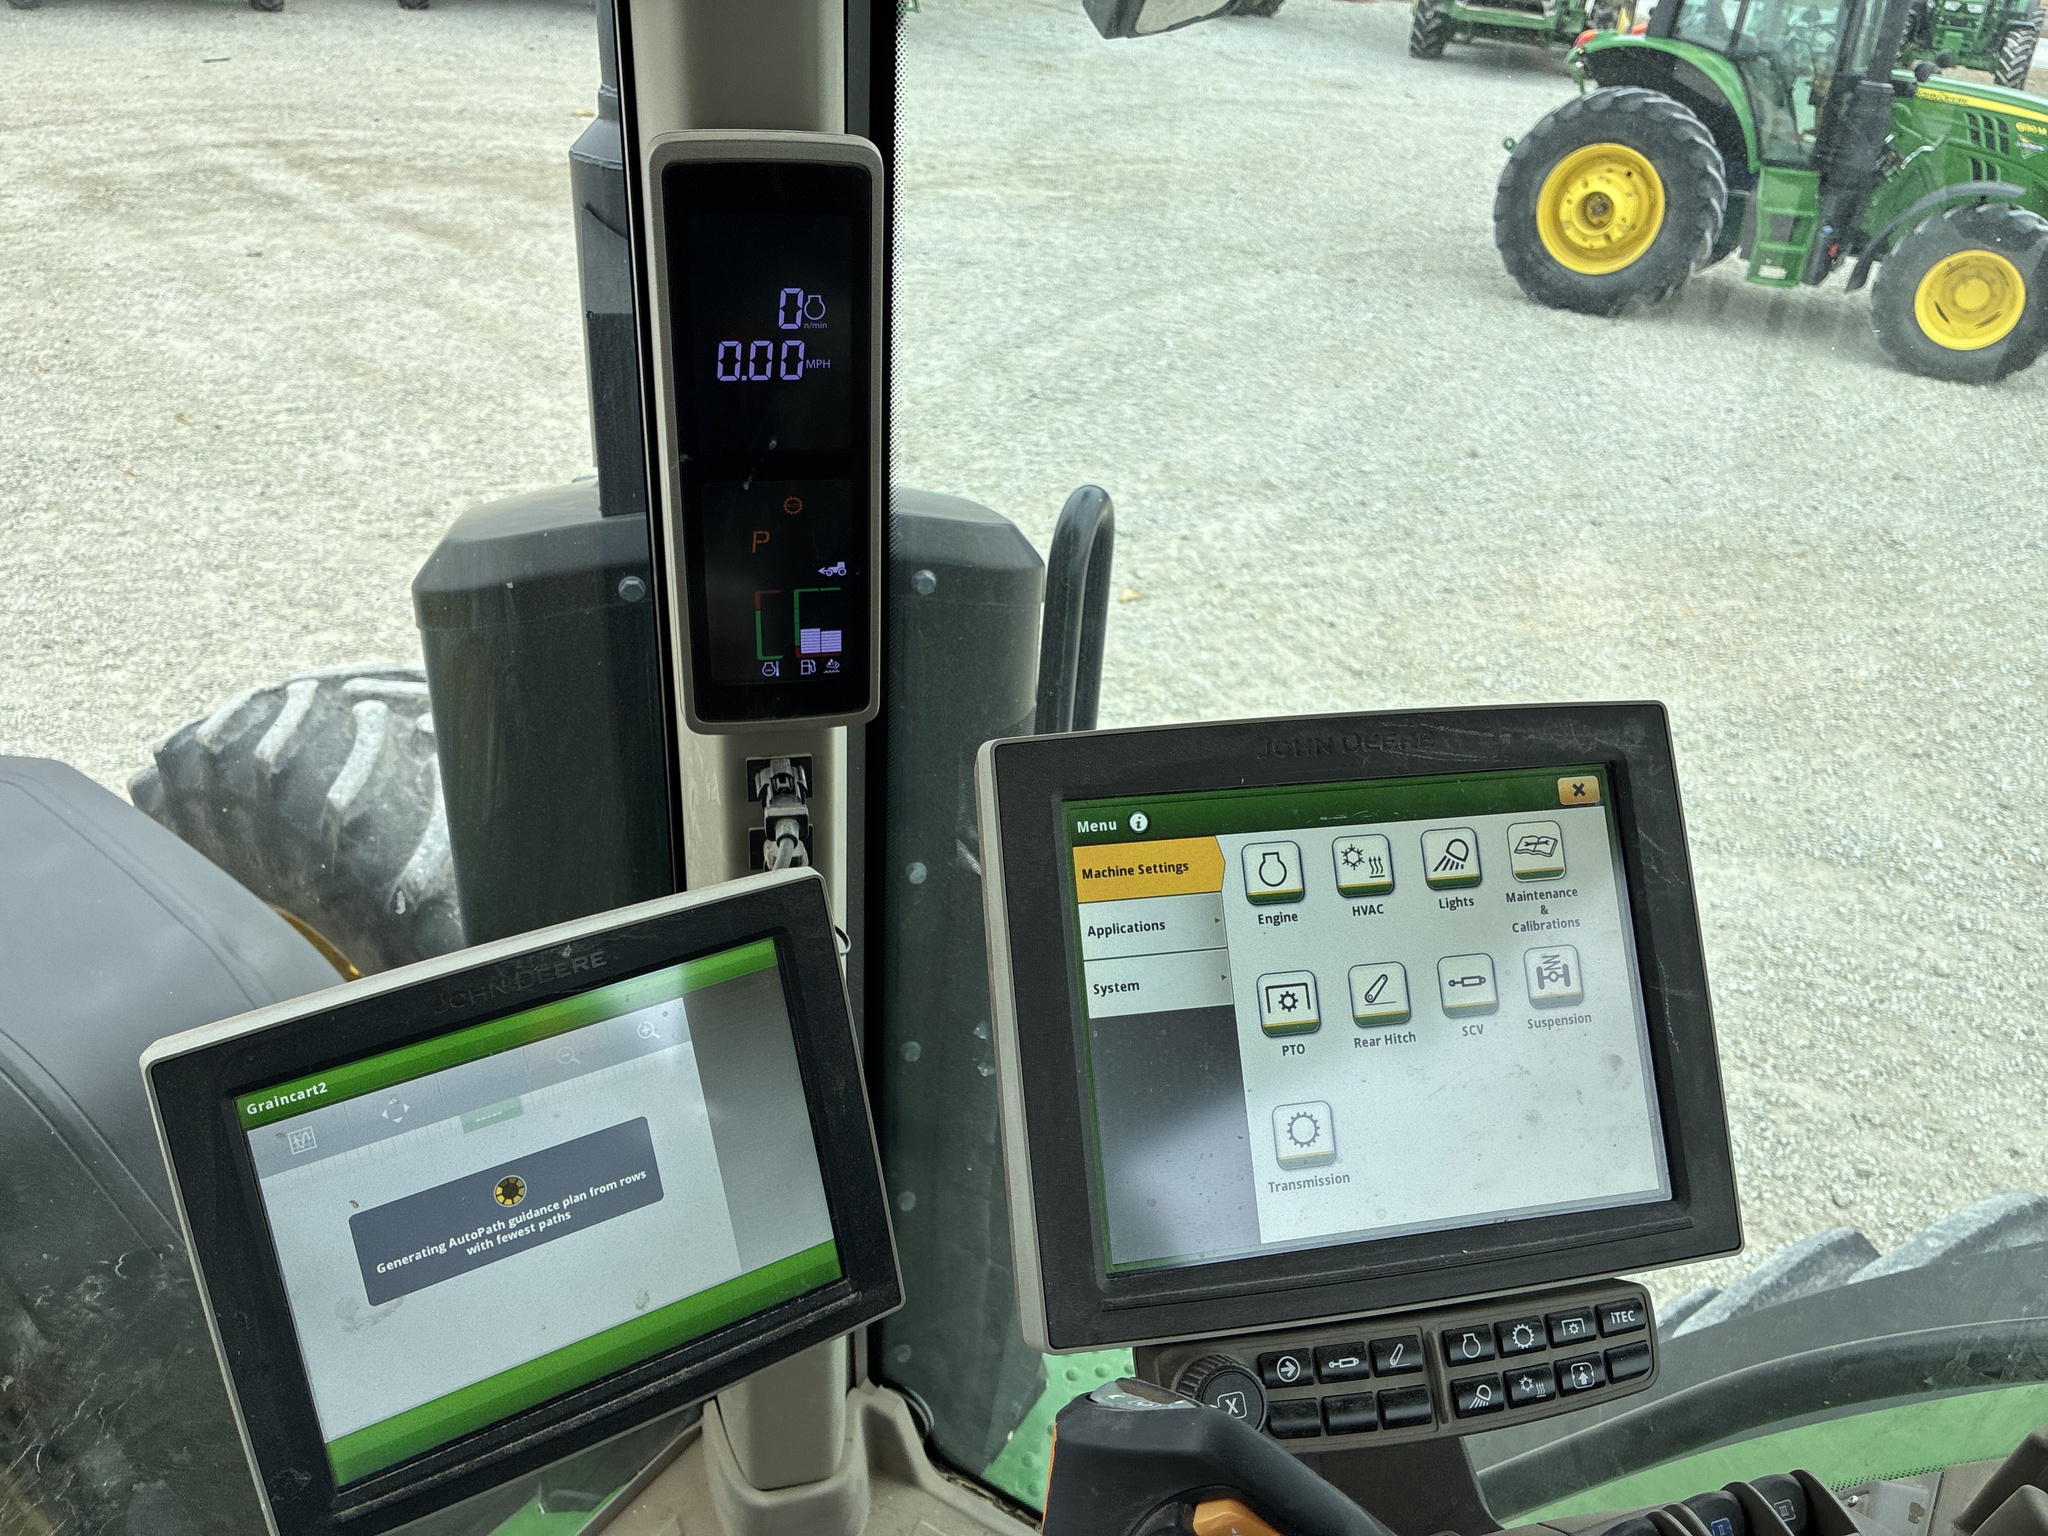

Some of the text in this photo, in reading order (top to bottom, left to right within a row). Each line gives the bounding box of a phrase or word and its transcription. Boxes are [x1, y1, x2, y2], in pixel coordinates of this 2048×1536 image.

[778, 287, 804, 330] 0
[803, 321, 828, 329] n/min
[716, 339, 805, 381] 0.00
[805, 359, 831, 369] MPH
[751, 529, 771, 553] P
[1256, 730, 1435, 760] JOHN DEERE
[1076, 818, 1118, 834] Menu
[1081, 860, 1190, 880] Machine Settings
[1438, 896, 1475, 911] Lights
[1505, 887, 1579, 904] Maintenance
[1257, 910, 1299, 927] Engine
[1351, 903, 1385, 917] HVAC
[1540, 904, 1549, 915] &
[1087, 919, 1166, 939] Applications
[1511, 916, 1581, 934] Calibrations
[515, 949, 608, 991] DEERE
[1093, 980, 1140, 998] System
[1461, 1023, 1484, 1037] SCV
[1526, 1012, 1593, 1032] Suspension
[1353, 1030, 1417, 1049] Rear Hitch
[1281, 1043, 1306, 1058] PTO
[246, 1082, 328, 1116] Graincart2
[1267, 1172, 1351, 1193] Transmission
[376, 1169, 647, 1274] Generating AutoPath guidance plan from rows
[466, 1209, 572, 1256] with fewest paths
[1610, 1309, 1637, 1325] iTEC
